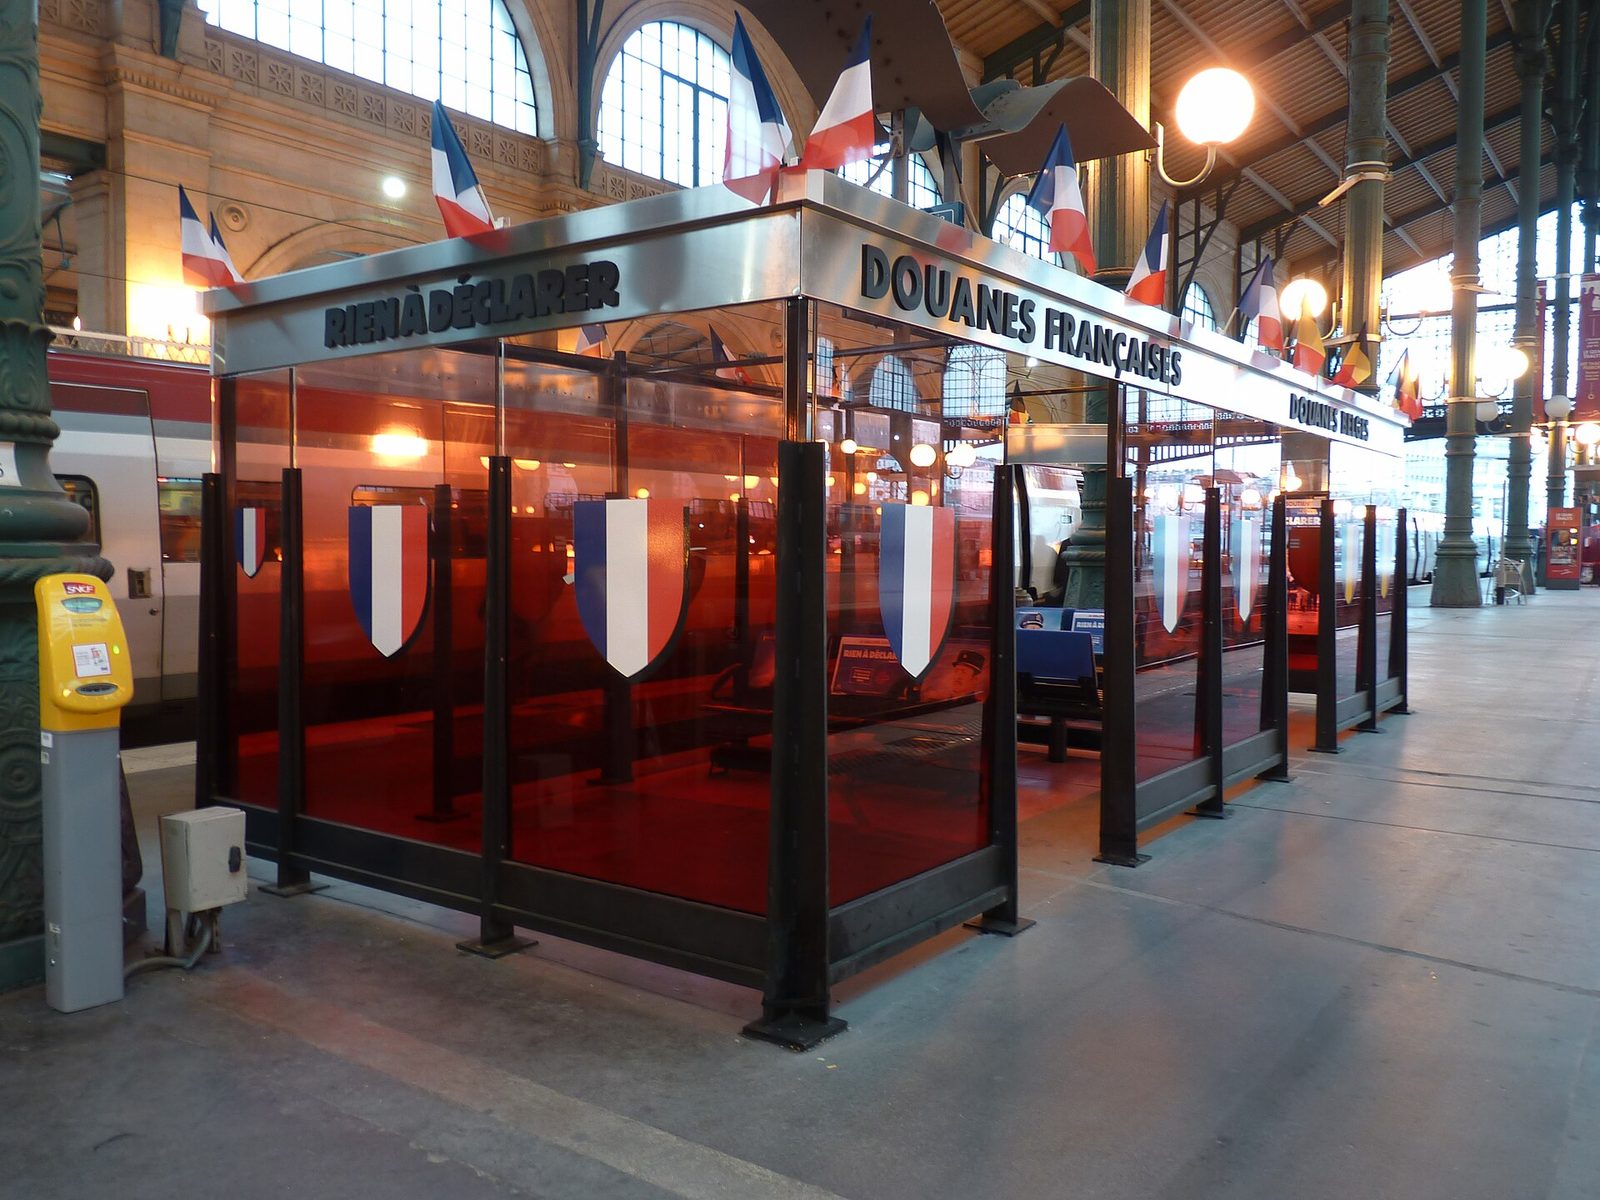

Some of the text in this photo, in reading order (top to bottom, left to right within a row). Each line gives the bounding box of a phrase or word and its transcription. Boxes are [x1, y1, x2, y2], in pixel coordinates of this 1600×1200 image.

[324, 260, 620, 348] RIEN À DÉCLARER
[861, 244, 1182, 386] DOUANES FRANÇAISES
[1289, 393, 1338, 432] DOUANES
[66, 585, 94, 594] SNCF
[843, 649, 862, 658] RIEN
